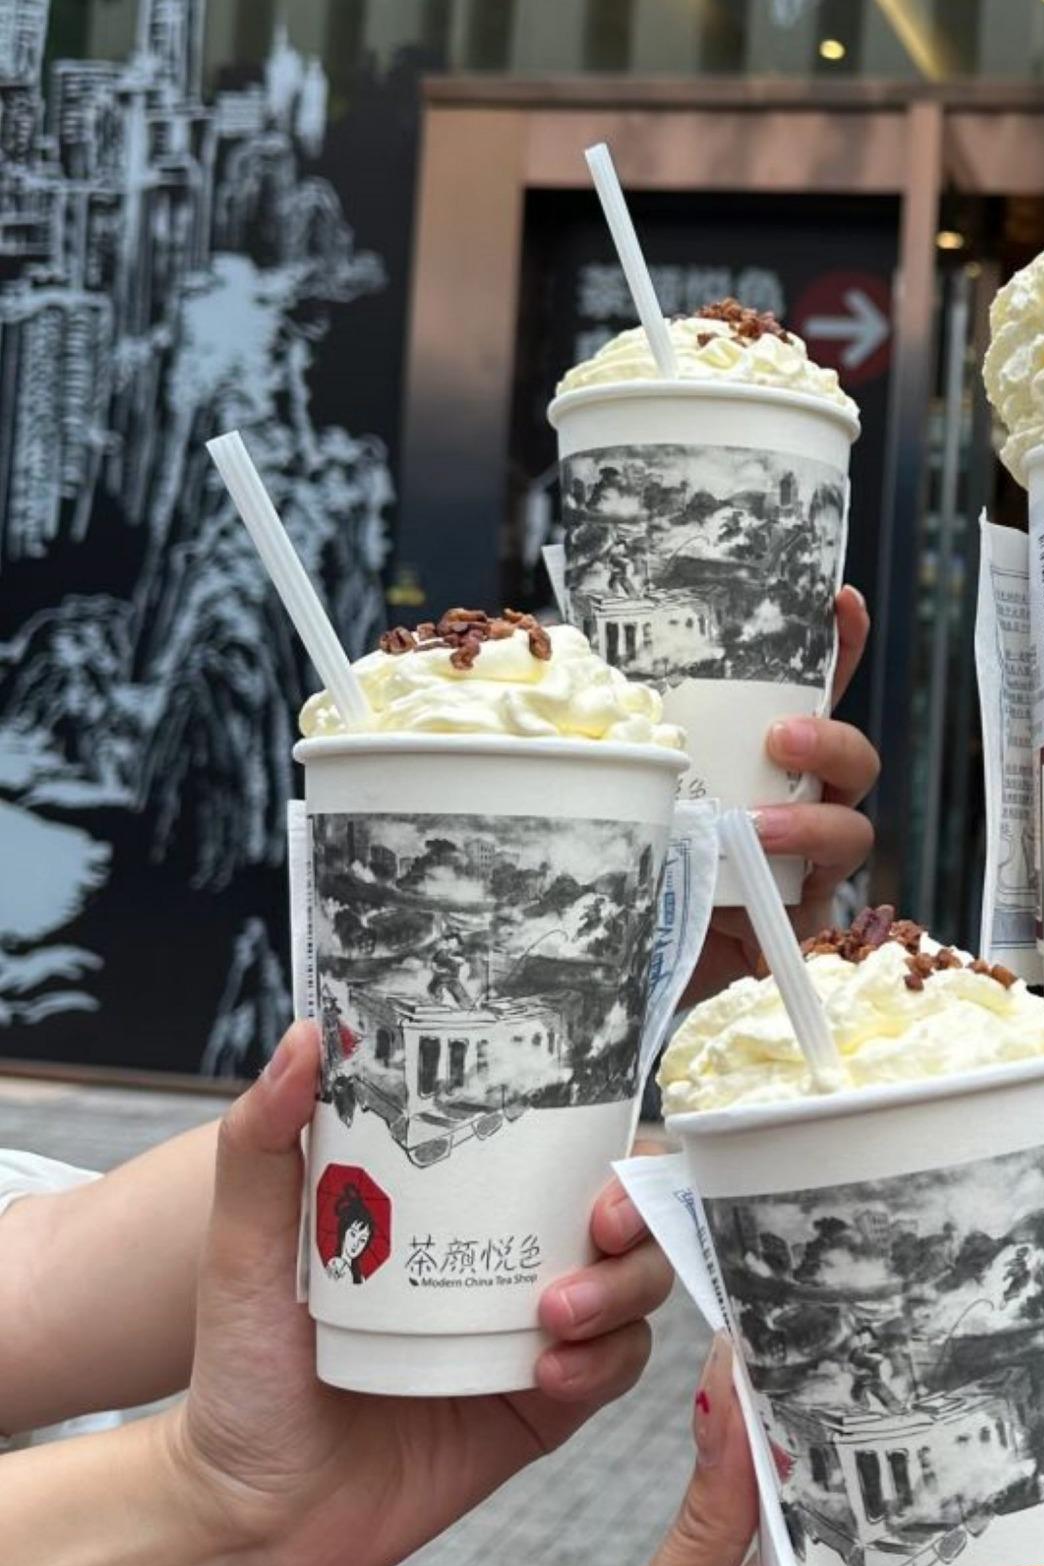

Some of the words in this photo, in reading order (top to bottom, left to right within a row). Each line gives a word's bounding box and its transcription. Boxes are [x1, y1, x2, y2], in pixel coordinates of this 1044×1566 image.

[421, 1277, 462, 1288] Modern
[465, 1277, 493, 1287] China
[496, 1275, 512, 1285] Tea
[514, 1274, 537, 1286] Shop
